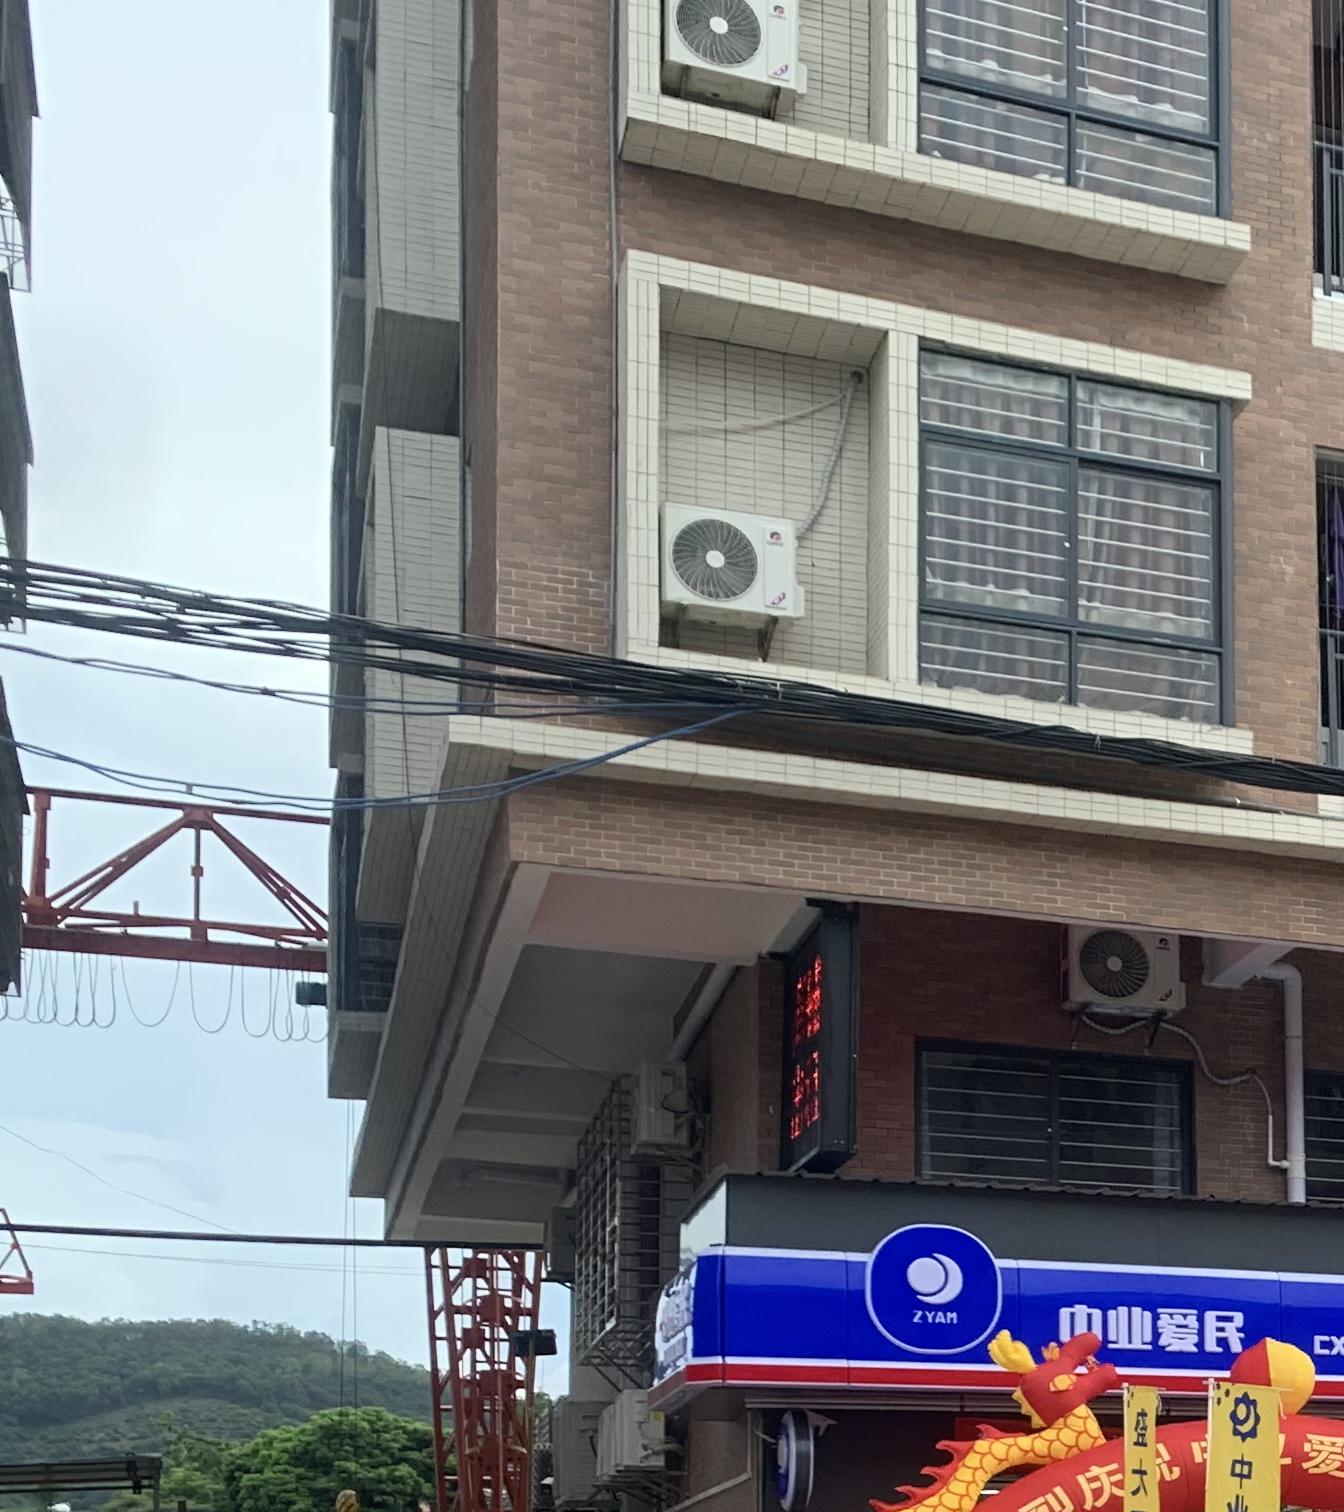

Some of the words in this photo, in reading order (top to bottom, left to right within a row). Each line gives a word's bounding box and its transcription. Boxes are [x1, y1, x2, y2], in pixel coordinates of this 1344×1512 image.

[912, 1310, 957, 1325] ZYAM
[1059, 1304, 1245, 1354] 中业爱民
